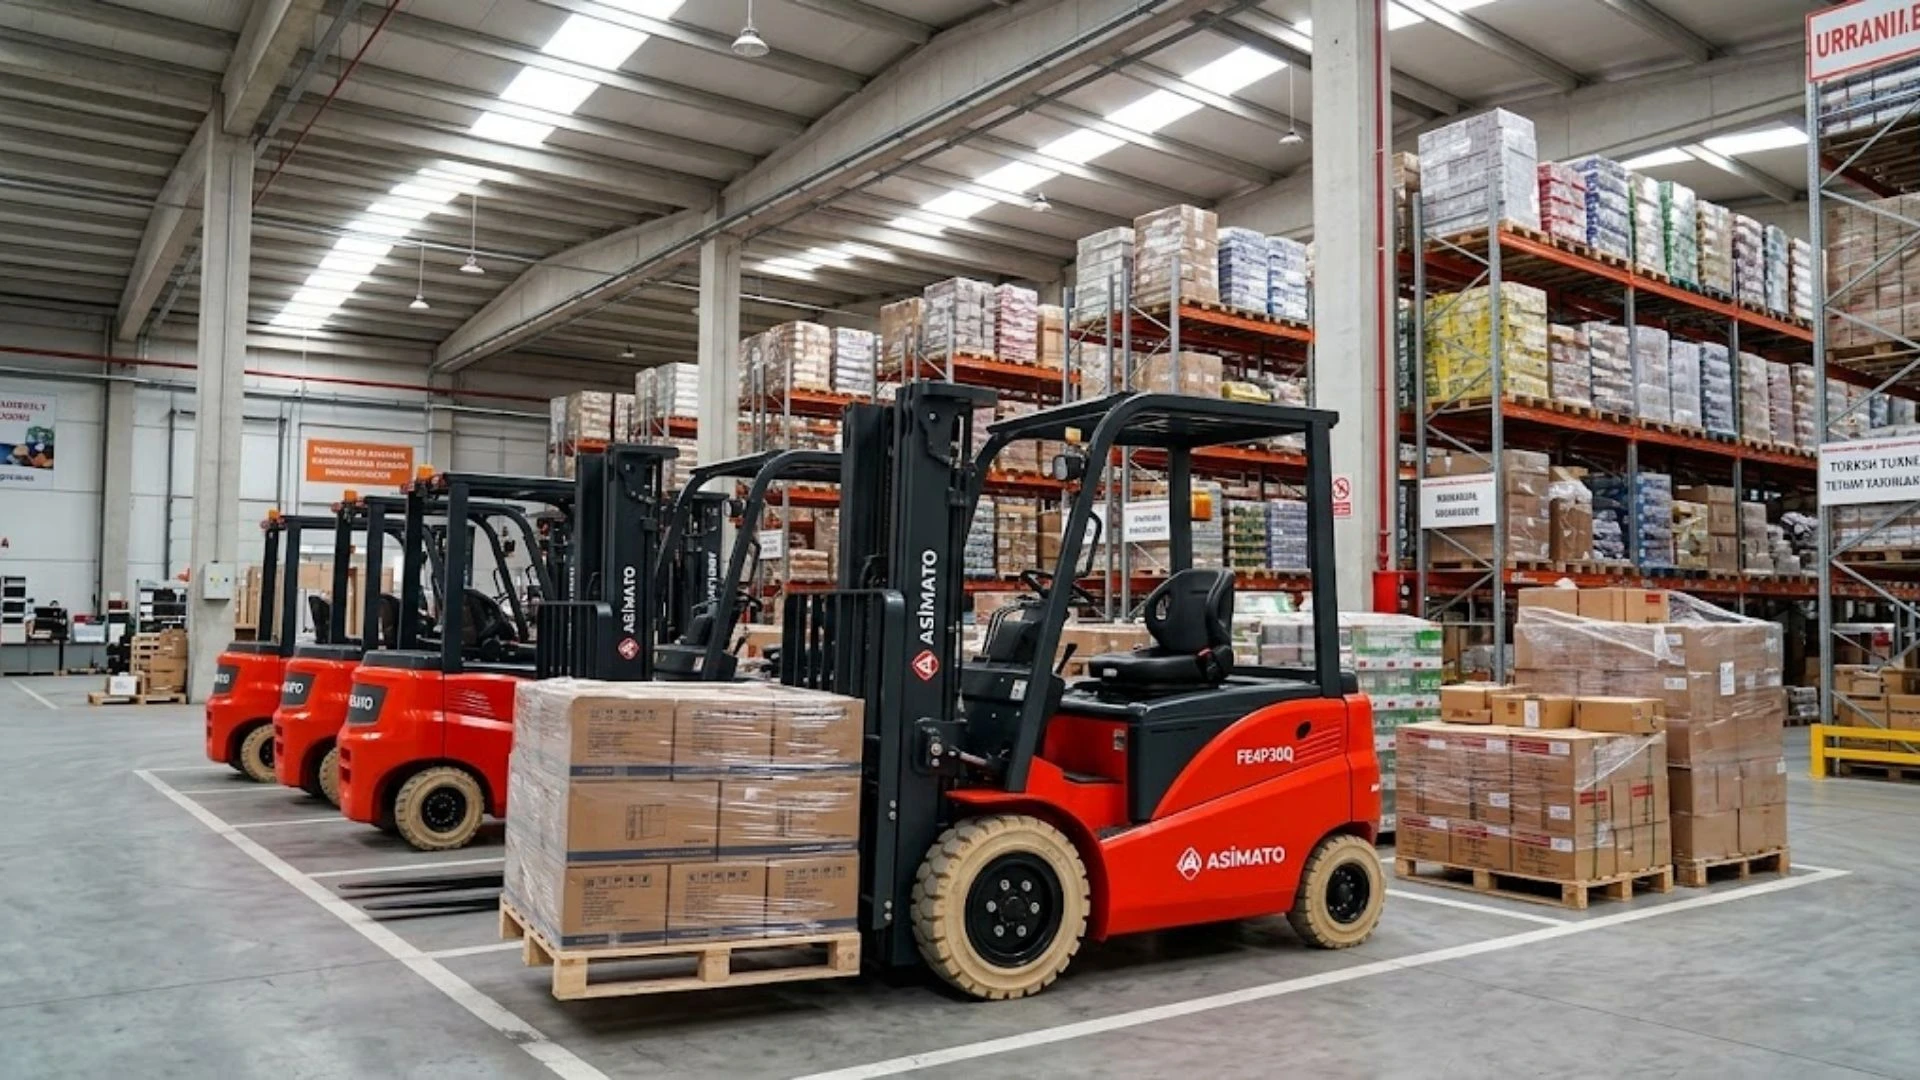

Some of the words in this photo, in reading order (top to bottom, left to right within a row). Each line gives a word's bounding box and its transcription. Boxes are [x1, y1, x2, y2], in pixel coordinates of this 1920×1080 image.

[916, 549, 938, 645] ASİMATO
[1236, 746, 1294, 765] FE4P30Q
[1207, 846, 1285, 869] ASİMATO
